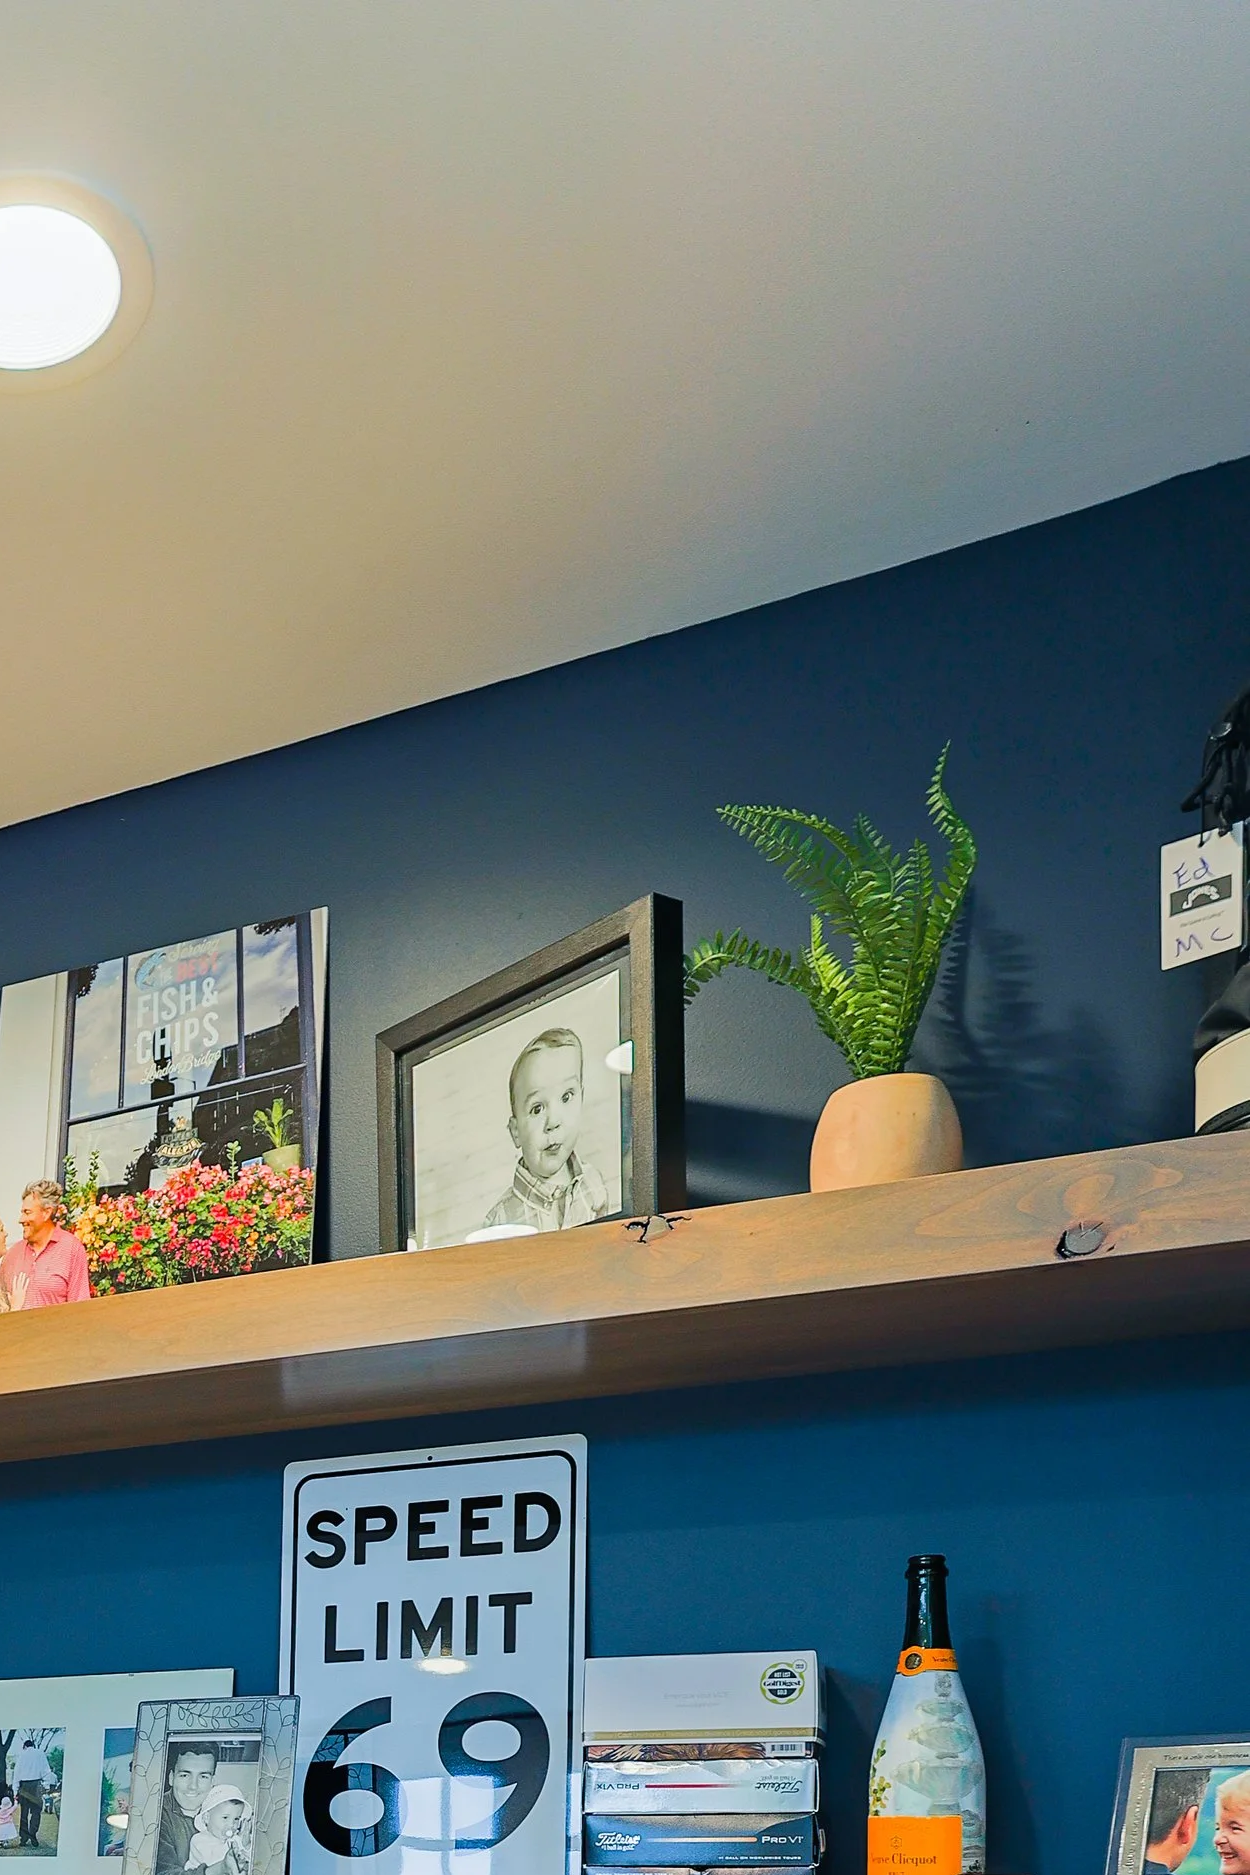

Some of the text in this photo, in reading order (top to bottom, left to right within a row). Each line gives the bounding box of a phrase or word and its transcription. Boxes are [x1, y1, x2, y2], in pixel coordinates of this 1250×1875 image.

[1172, 857, 1215, 889] Ed
[136, 976, 219, 1029] FISH &
[136, 1011, 220, 1065] CHIPS
[304, 1491, 562, 1570] SPEED
[324, 1591, 533, 1664] LIMIT
[302, 1690, 551, 1858] 69
[755, 1780, 803, 1794] Titleist
[594, 1832, 641, 1847] Titleist
[761, 1835, 787, 1844] PRO
[891, 1852, 937, 1867] Clicquot
